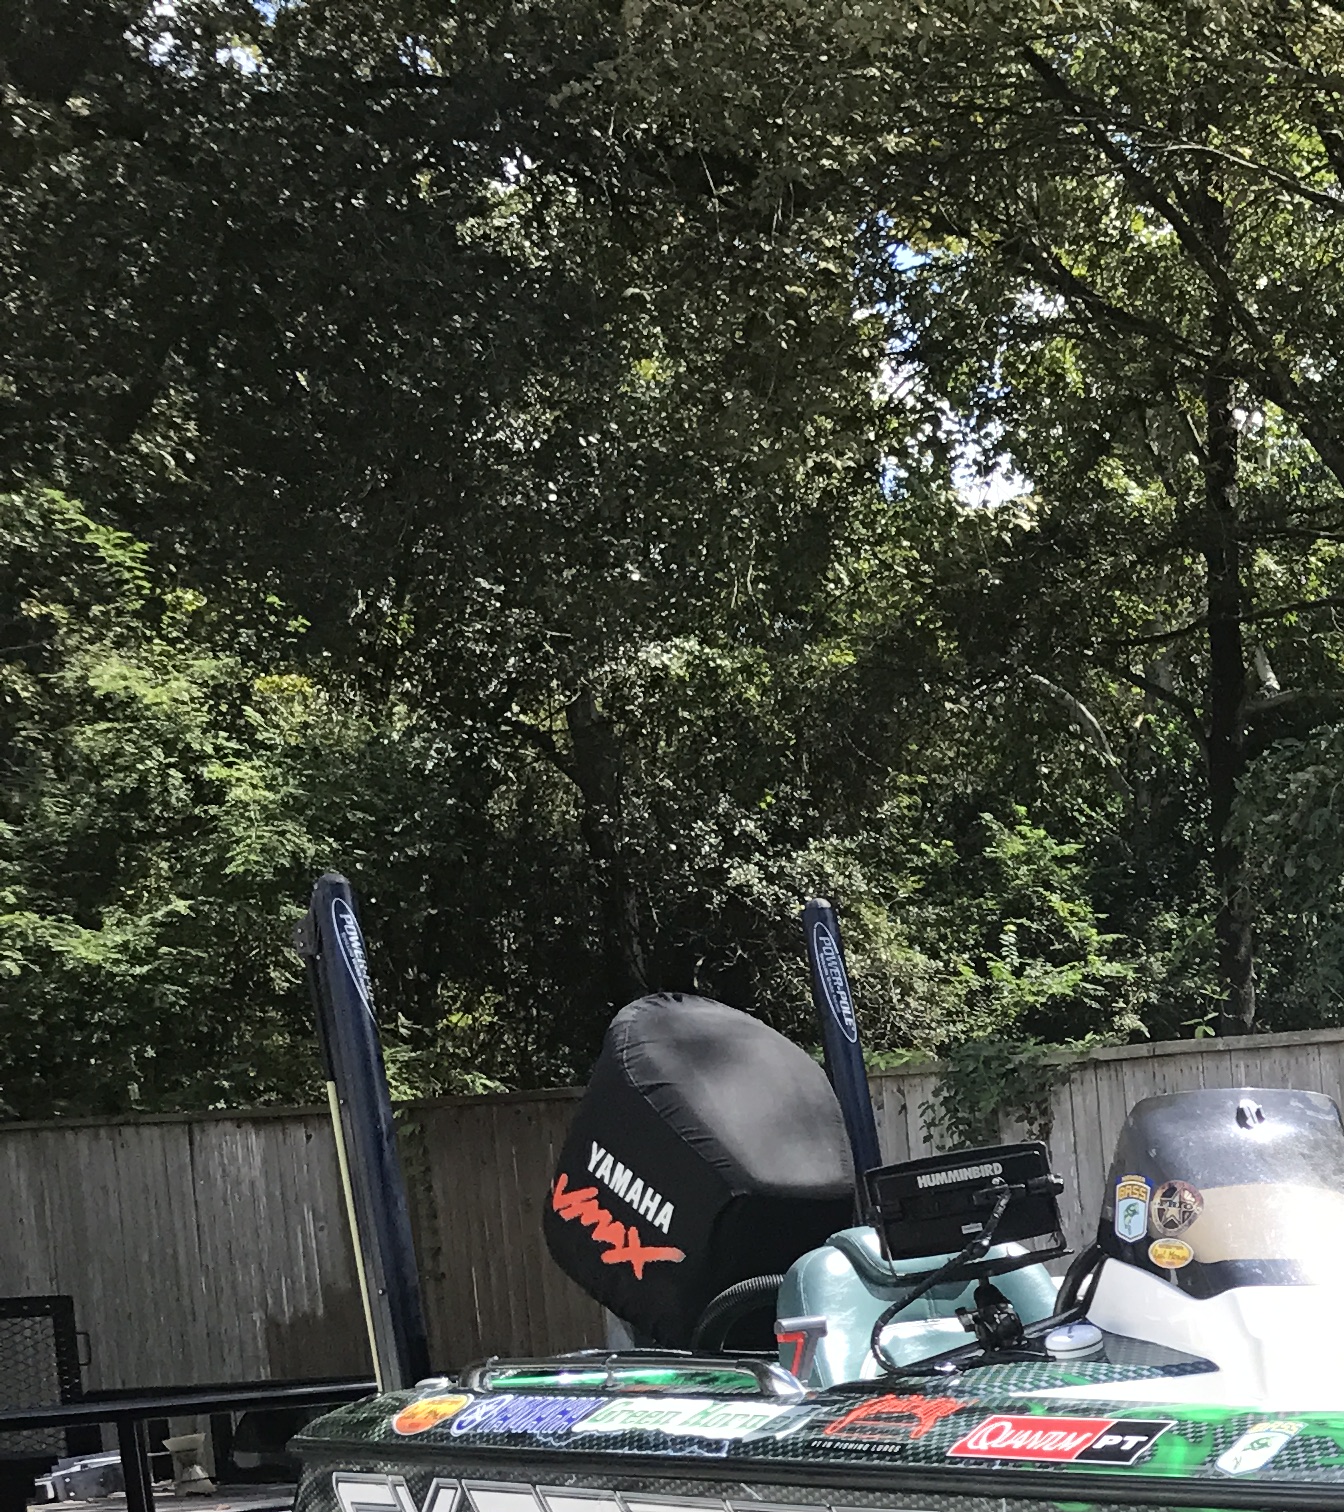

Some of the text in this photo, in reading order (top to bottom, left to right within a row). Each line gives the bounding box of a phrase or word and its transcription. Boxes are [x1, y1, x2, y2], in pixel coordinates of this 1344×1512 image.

[587, 1140, 675, 1234] YAMAHA
[917, 1162, 1003, 1188] HUMMINBIRD
[966, 1421, 1149, 1452] QUANTUM PT
